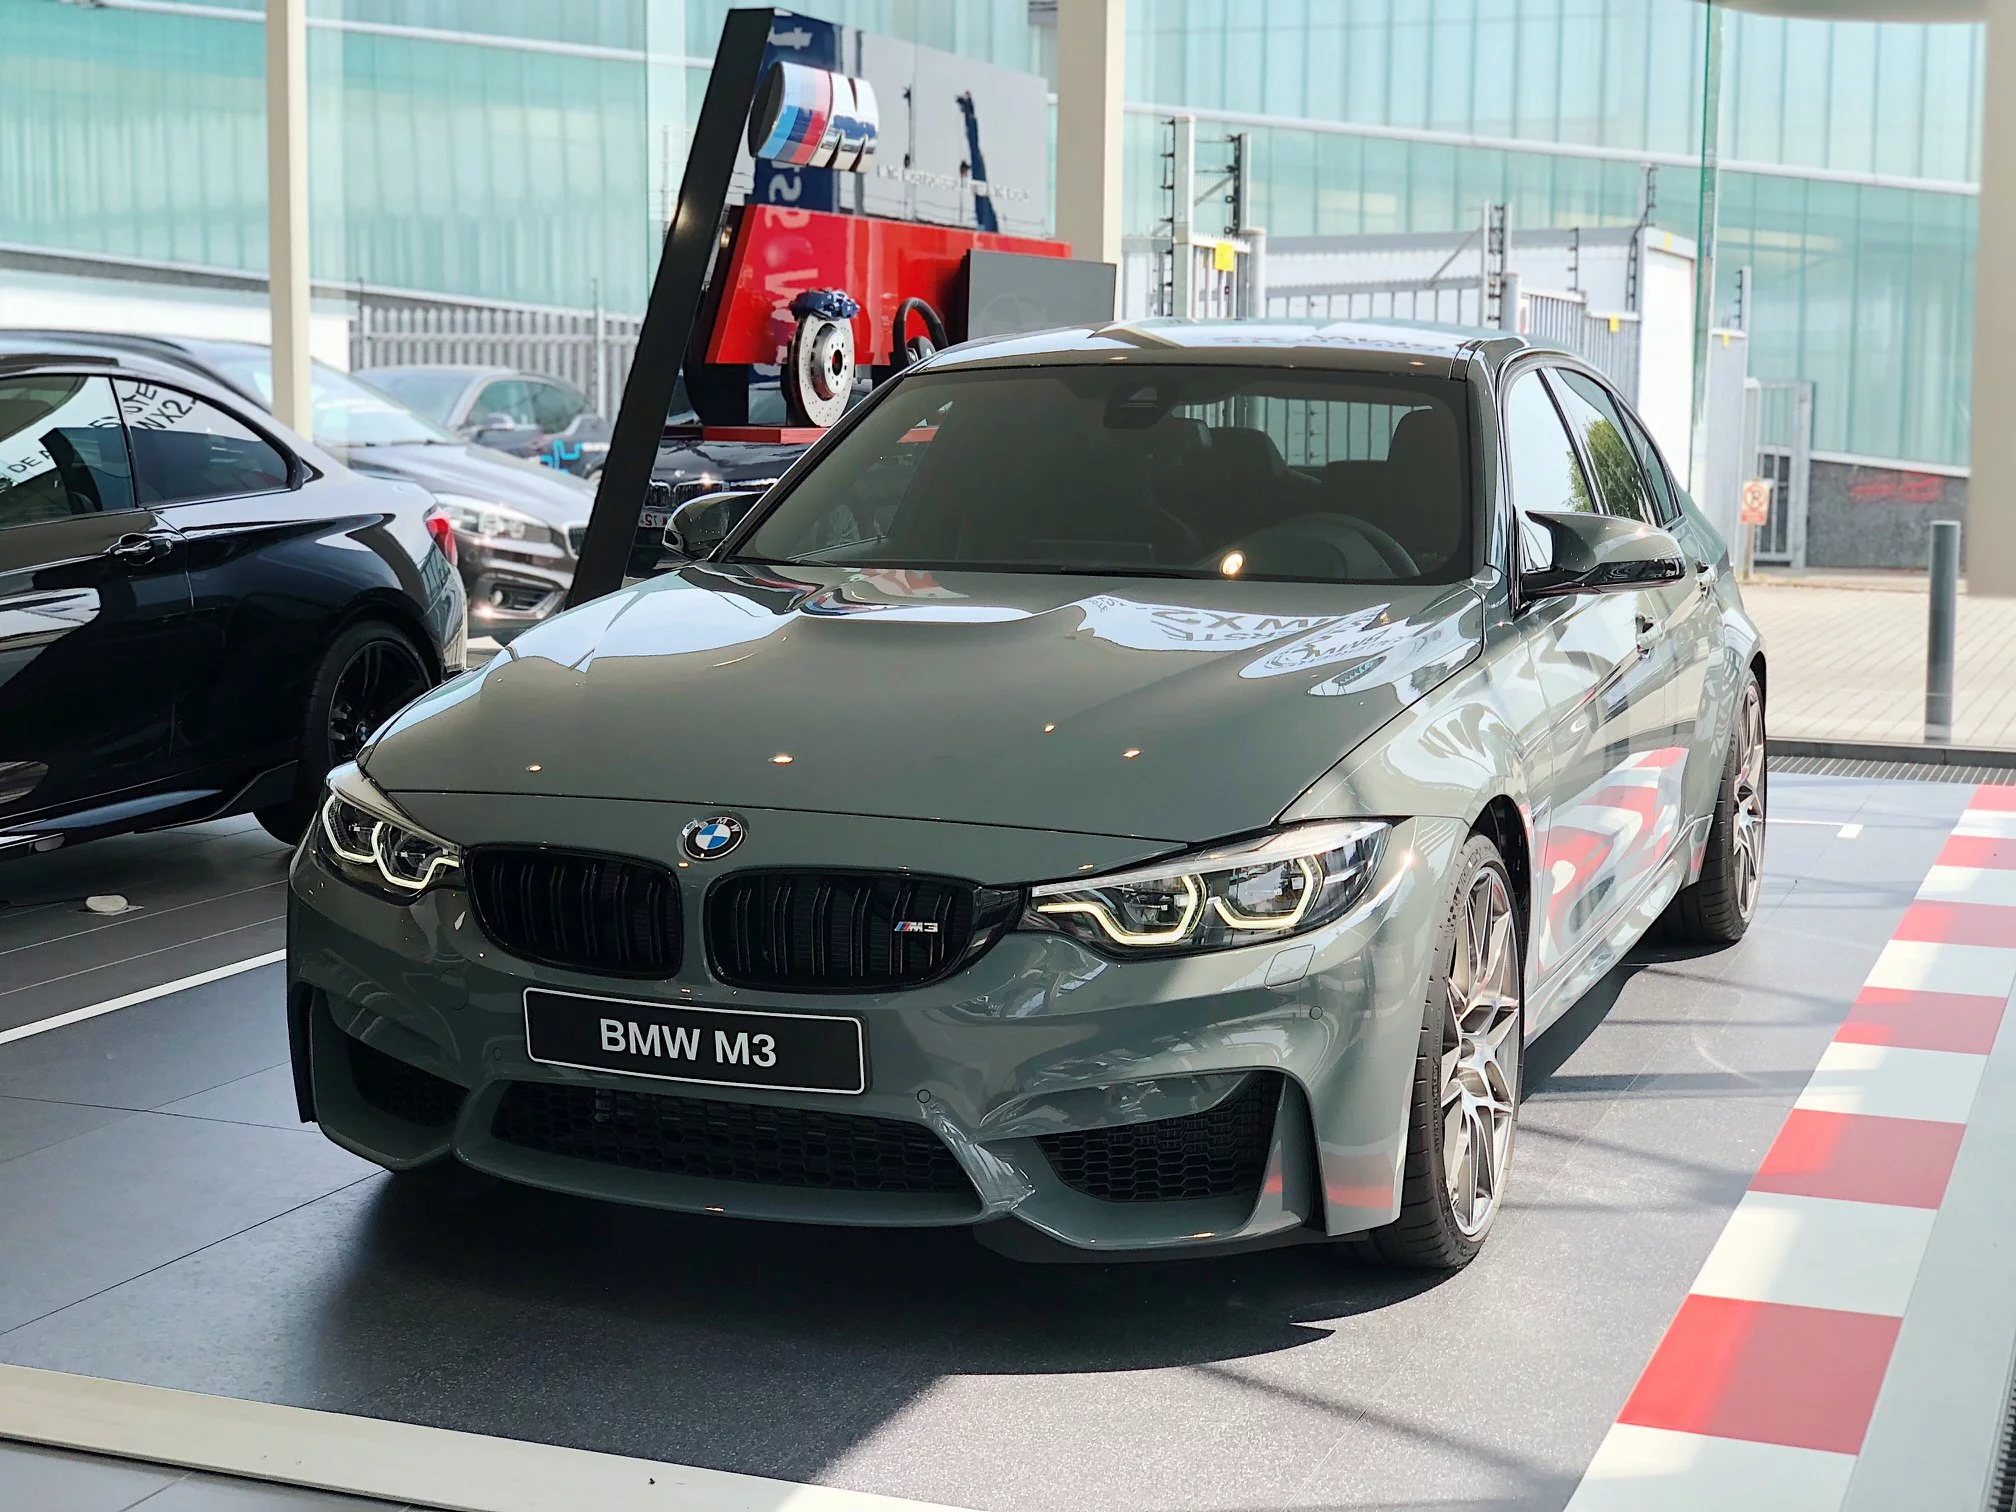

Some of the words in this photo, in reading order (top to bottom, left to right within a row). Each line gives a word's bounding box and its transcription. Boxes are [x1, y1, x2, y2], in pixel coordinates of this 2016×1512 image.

[715, 817, 741, 833] MW
[600, 1018, 700, 1061] BMW
[714, 1030, 777, 1067] M3
